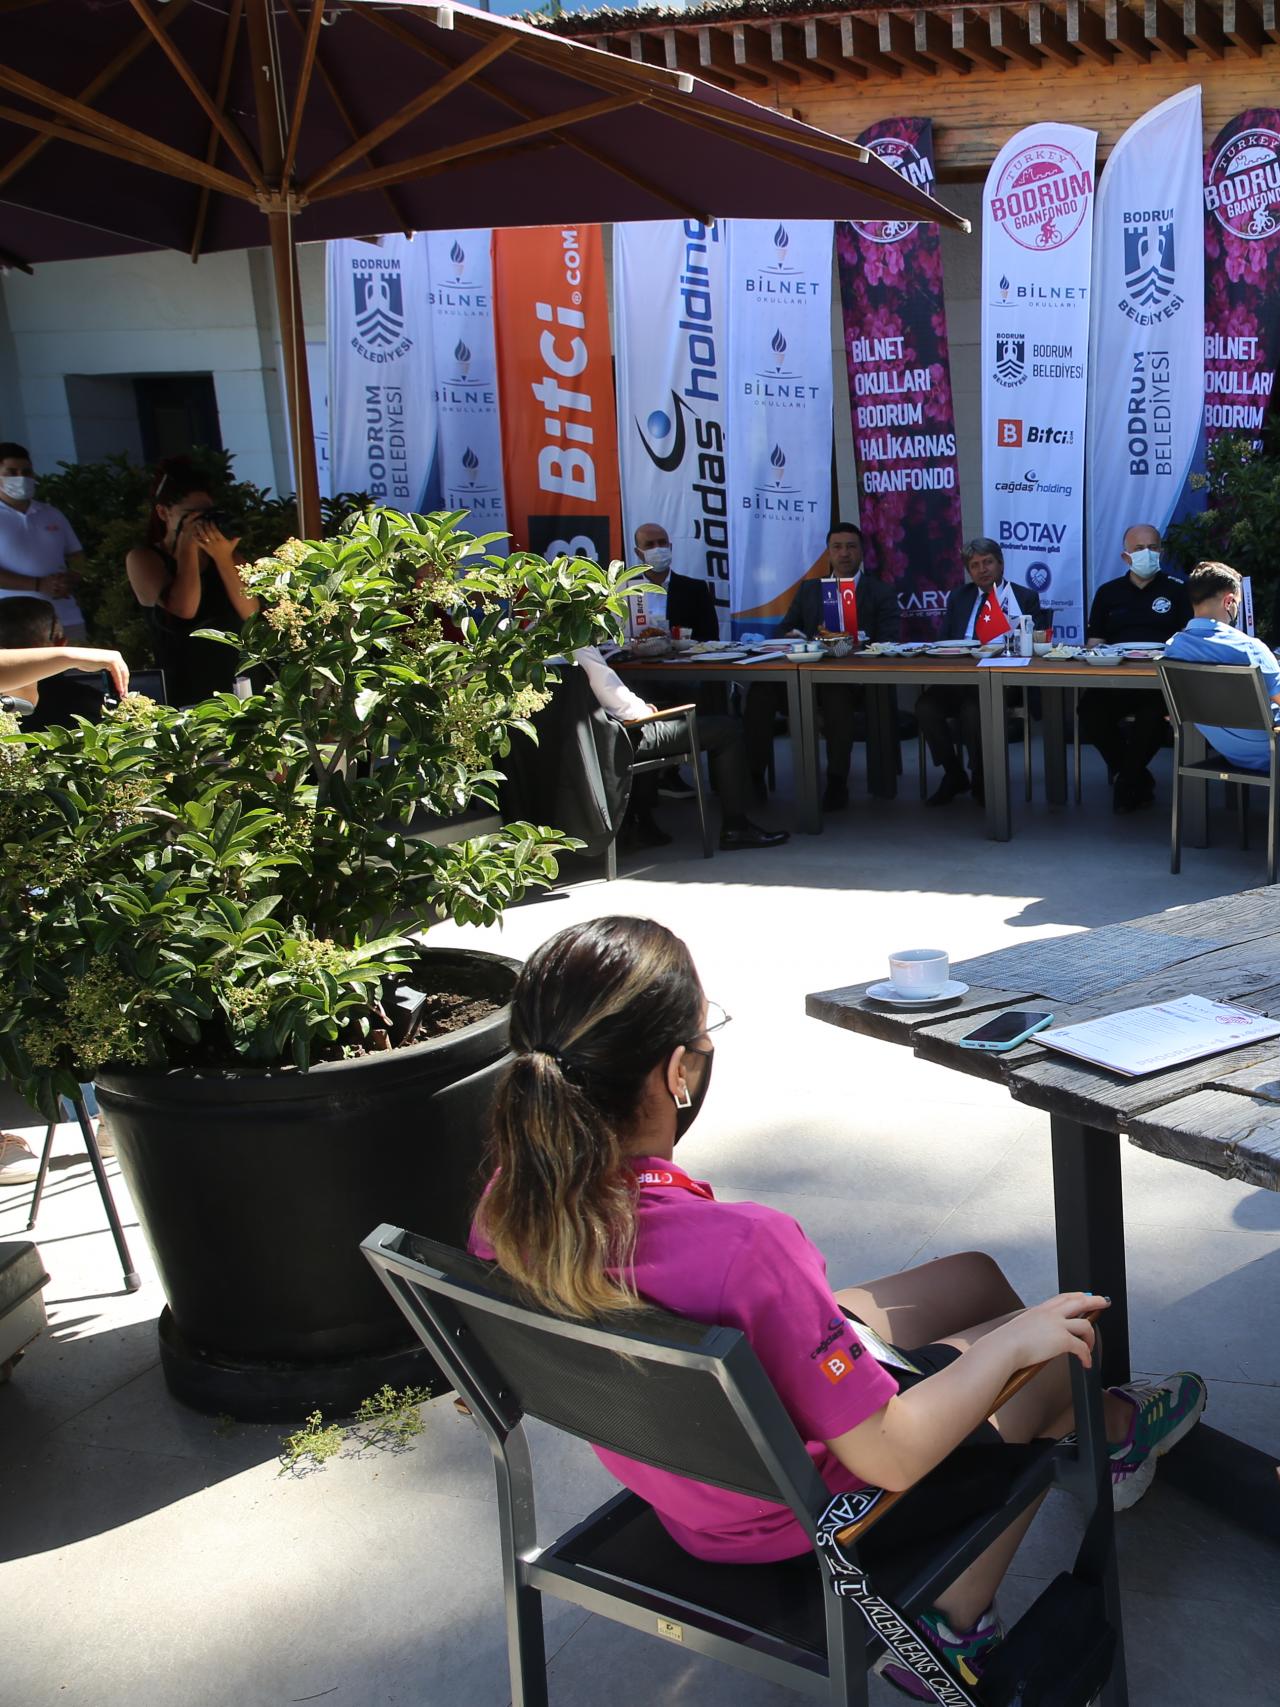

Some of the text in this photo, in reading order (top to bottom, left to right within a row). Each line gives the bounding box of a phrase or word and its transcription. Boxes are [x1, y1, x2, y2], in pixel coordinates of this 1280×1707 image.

[1219, 136, 1280, 168] TURKEY
[1006, 151, 1068, 181] TURKEY
[991, 170, 1093, 222] BODRUM
[1014, 200, 1078, 229] GRANFONDO
[351, 258, 401, 270] BODRUM
[429, 289, 488, 307] BİLNE
[745, 275, 820, 295] BİLNET
[1016, 283, 1087, 299] BİLNET
[756, 296, 807, 304] OKULLARI
[1028, 301, 1076, 309] OKULLARI
[351, 337, 415, 364] BELEDİYESİ
[852, 335, 905, 363] BİLNET
[1033, 344, 1073, 358] BODRUM
[1204, 332, 1259, 360] BİLNET
[855, 368, 931, 395] OKULLARI
[1033, 362, 1084, 379] BELEDİYESİ
[1204, 370, 1273, 395] OKULLARI
[743, 380, 819, 399] BİLNET
[857, 402, 923, 429] BODRUM
[1127, 351, 1149, 475] BODRUM
[1147, 350, 1172, 475] BELEDİYESİ
[1204, 404, 1264, 429] BODRUM
[365, 385, 388, 500] BODRUM
[386, 385, 410, 498] BELEDİYESİ
[860, 433, 956, 461] HALİKARNAS
[863, 466, 954, 493] GRANFONDO
[1036, 483, 1072, 497] holding
[742, 493, 817, 513] BİLNET
[1000, 521, 1067, 544] BOTAV
